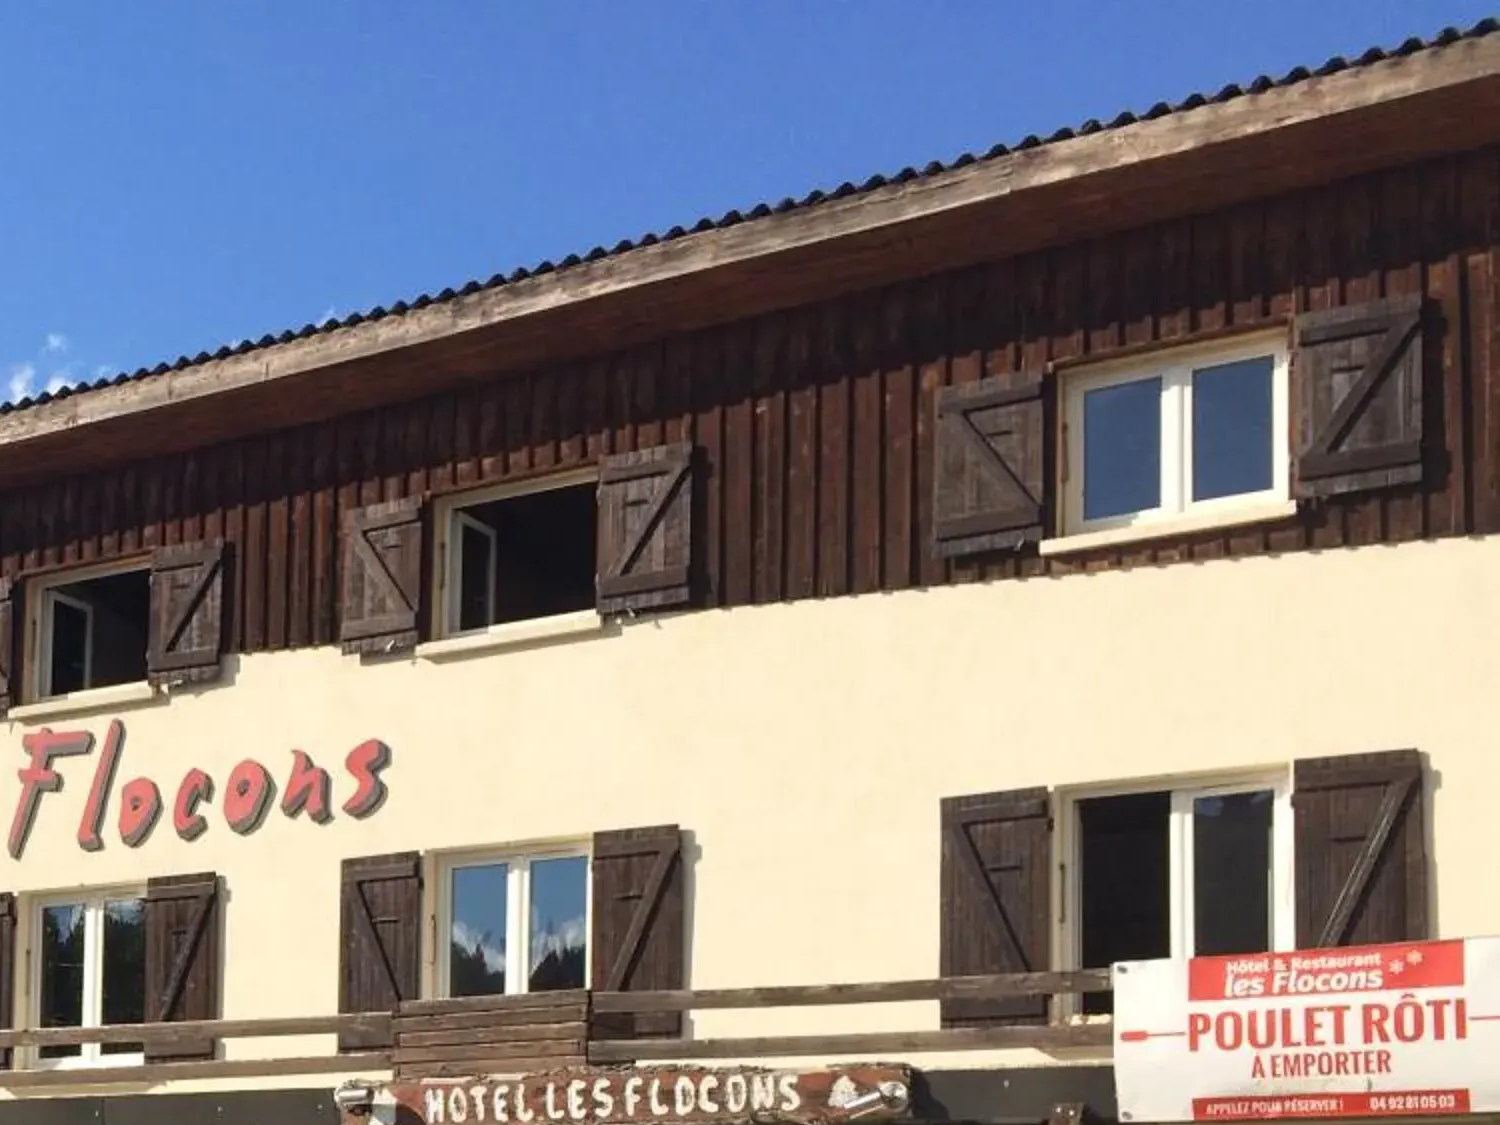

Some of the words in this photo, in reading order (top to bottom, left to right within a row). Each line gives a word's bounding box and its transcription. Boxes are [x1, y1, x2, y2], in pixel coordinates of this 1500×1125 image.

[8, 719, 392, 859] Flocons
[1226, 957, 1269, 974] Hôtel
[1274, 957, 1287, 971] &
[1291, 952, 1381, 971] Restaurant
[1224, 971, 1265, 997] les
[1272, 969, 1384, 994] Flocons
[1188, 1005, 1351, 1052] POULET
[1362, 994, 1467, 1044] RÔTI
[1271, 1050, 1392, 1078] EMPORTER
[425, 1083, 534, 1124] HOTEL
[546, 1077, 614, 1120] LES
[625, 1074, 801, 1118] FLOCONS
